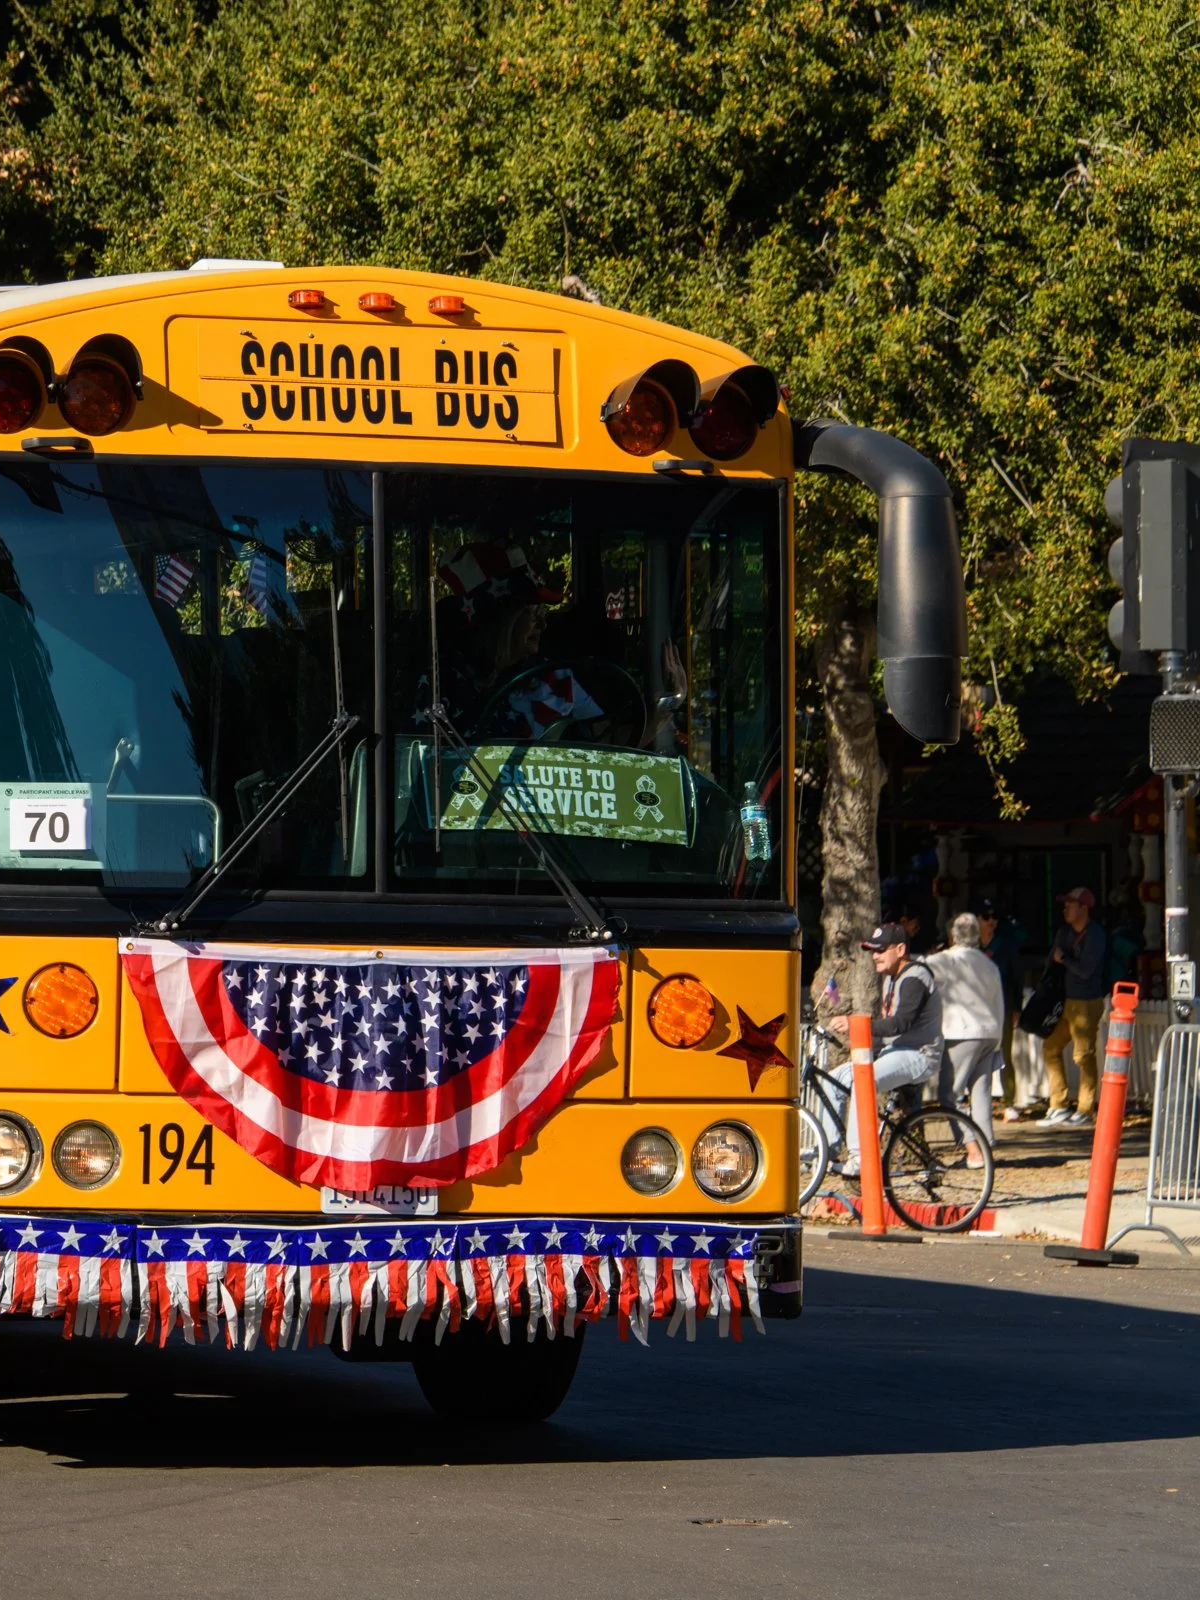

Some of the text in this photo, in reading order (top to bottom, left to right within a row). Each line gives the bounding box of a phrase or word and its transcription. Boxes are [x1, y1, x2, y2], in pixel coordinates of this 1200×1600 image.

[240, 340, 519, 431] SCHOOL BUS
[499, 764, 584, 788] SALUTE
[587, 769, 615, 791] TO
[502, 787, 618, 820] SERVICE
[24, 811, 70, 843] 70
[139, 1122, 215, 1185] 194
